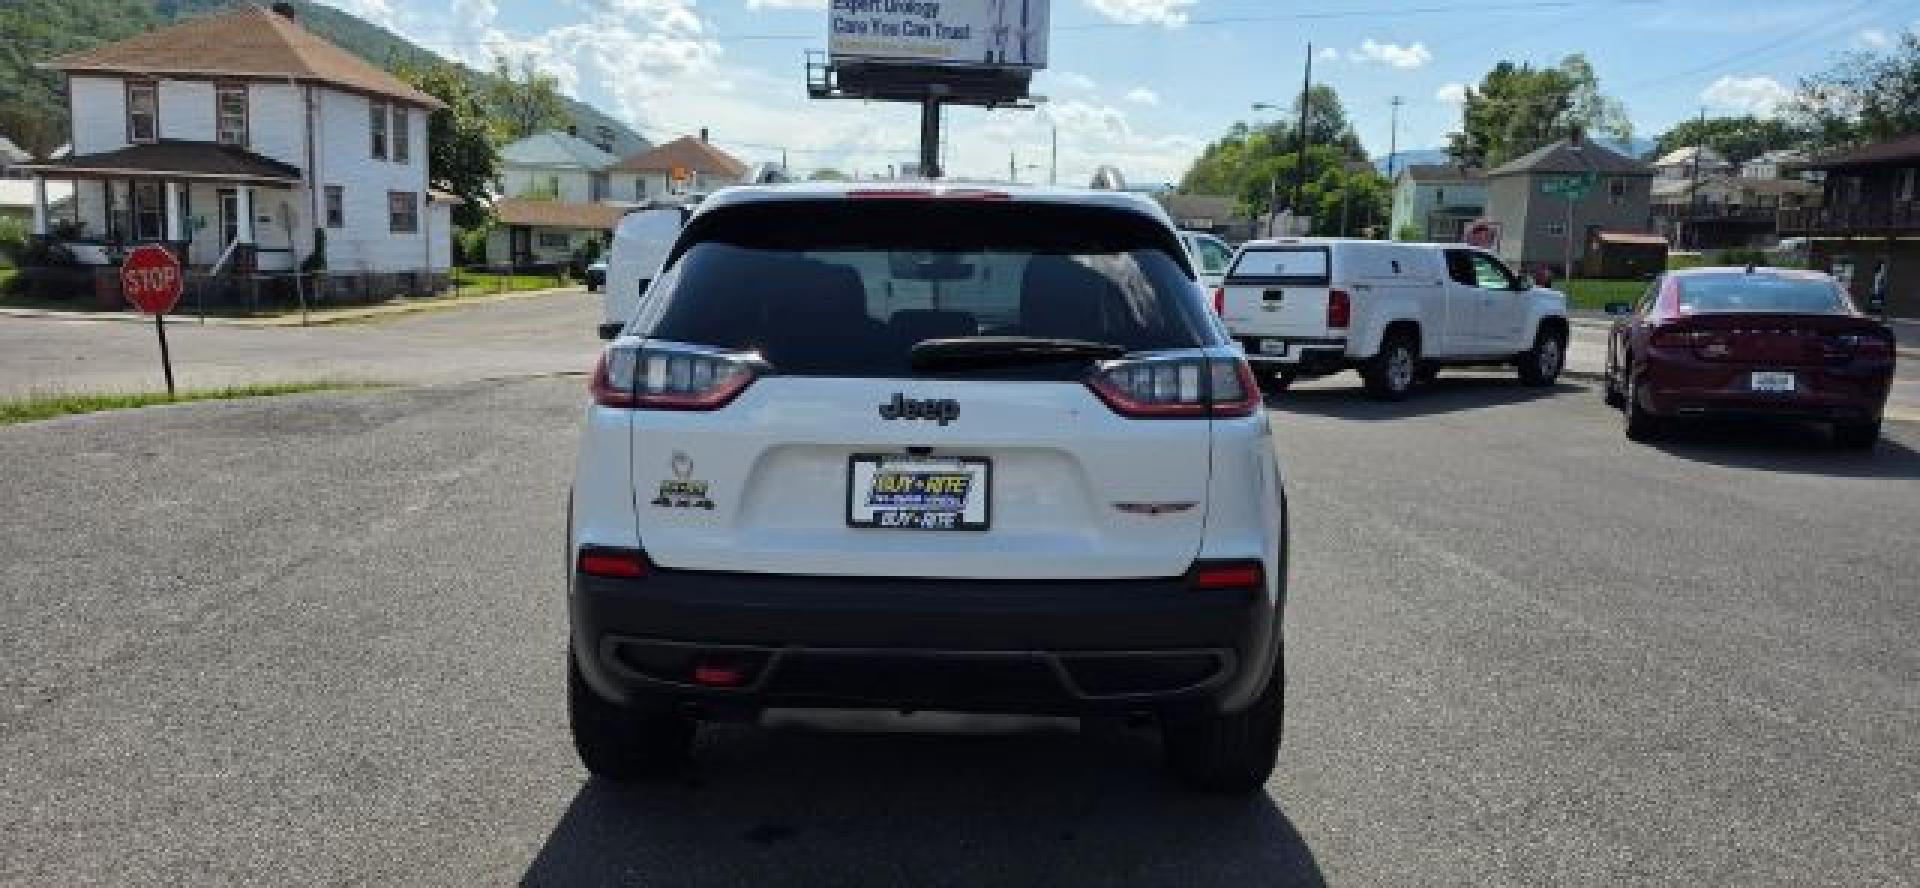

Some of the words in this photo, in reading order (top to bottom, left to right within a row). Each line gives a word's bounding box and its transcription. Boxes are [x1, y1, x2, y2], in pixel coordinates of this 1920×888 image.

[833, 0, 882, 15] Expert
[885, 0, 940, 18] Urology
[833, 17, 868, 34] Care
[871, 18, 898, 36] You
[902, 20, 931, 37] Can
[935, 23, 971, 40] Trust
[127, 267, 176, 293] STOP
[879, 392, 960, 426] Jeep
